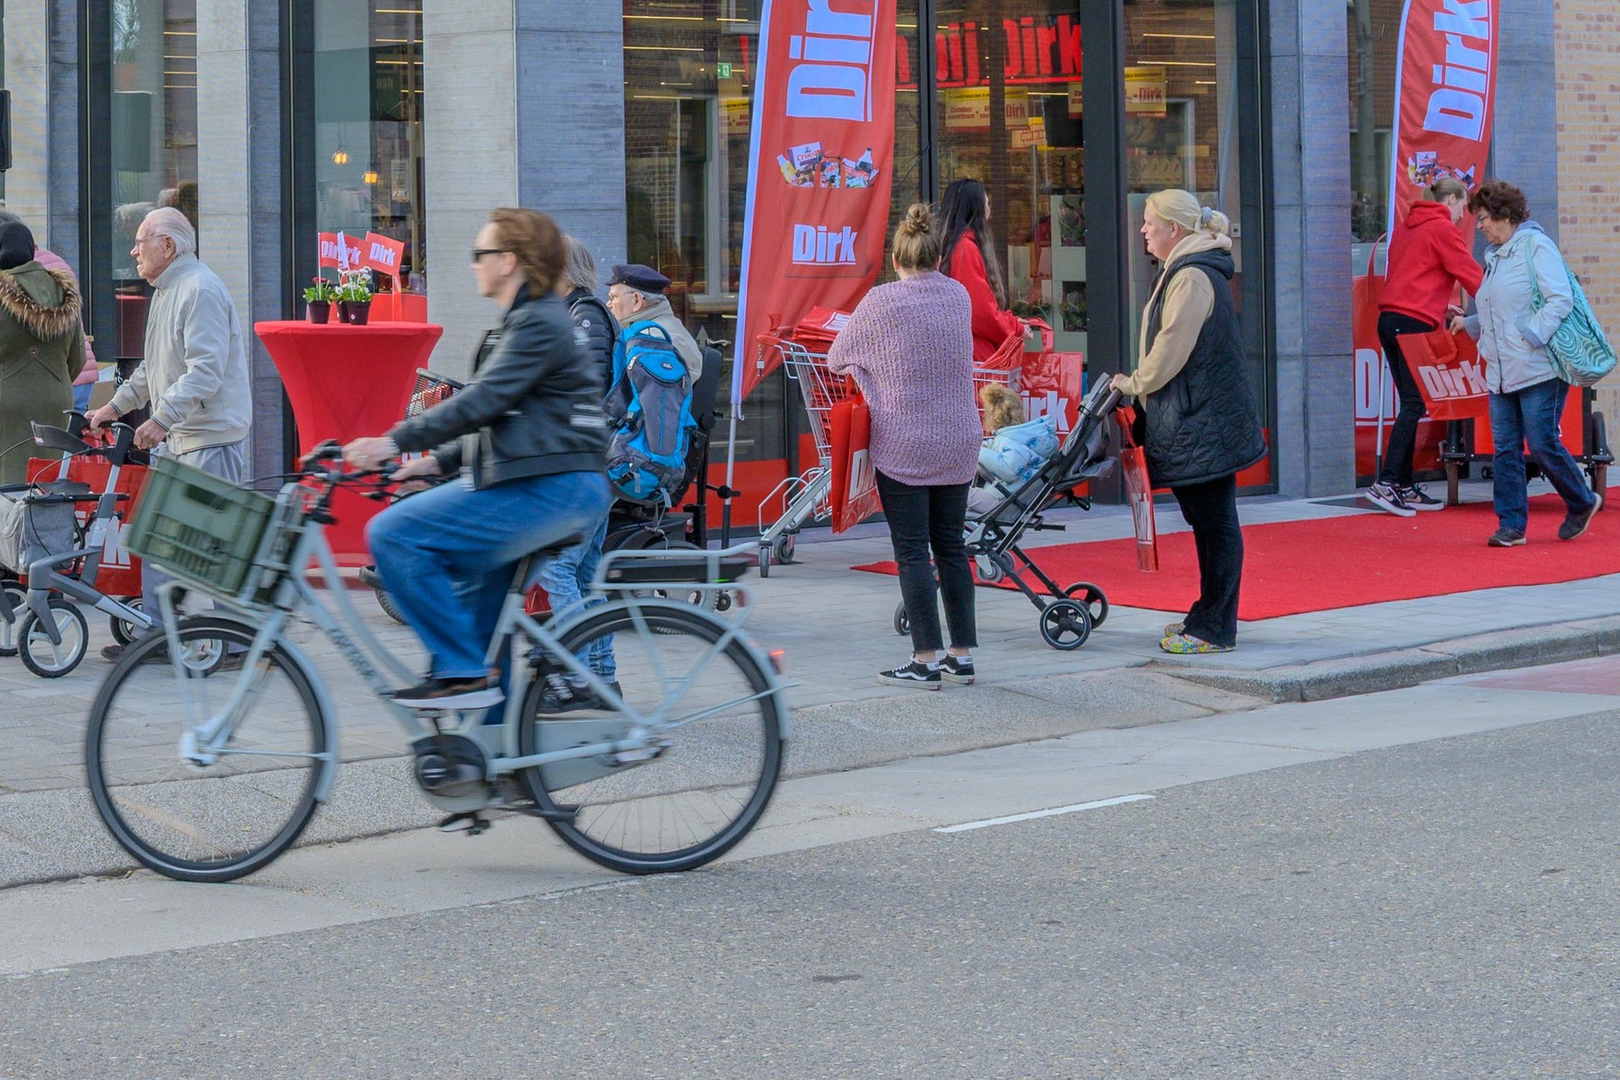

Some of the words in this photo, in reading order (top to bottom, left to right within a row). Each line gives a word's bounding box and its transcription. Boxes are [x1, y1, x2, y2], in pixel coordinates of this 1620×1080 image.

[1005, 103, 1026, 117] Dirk
[321, 241, 338, 258] Dir
[369, 242, 395, 267] Dirk
[792, 224, 857, 263] Dirk
[1417, 360, 1489, 399] Dirk
[1020, 390, 1070, 431] irk
